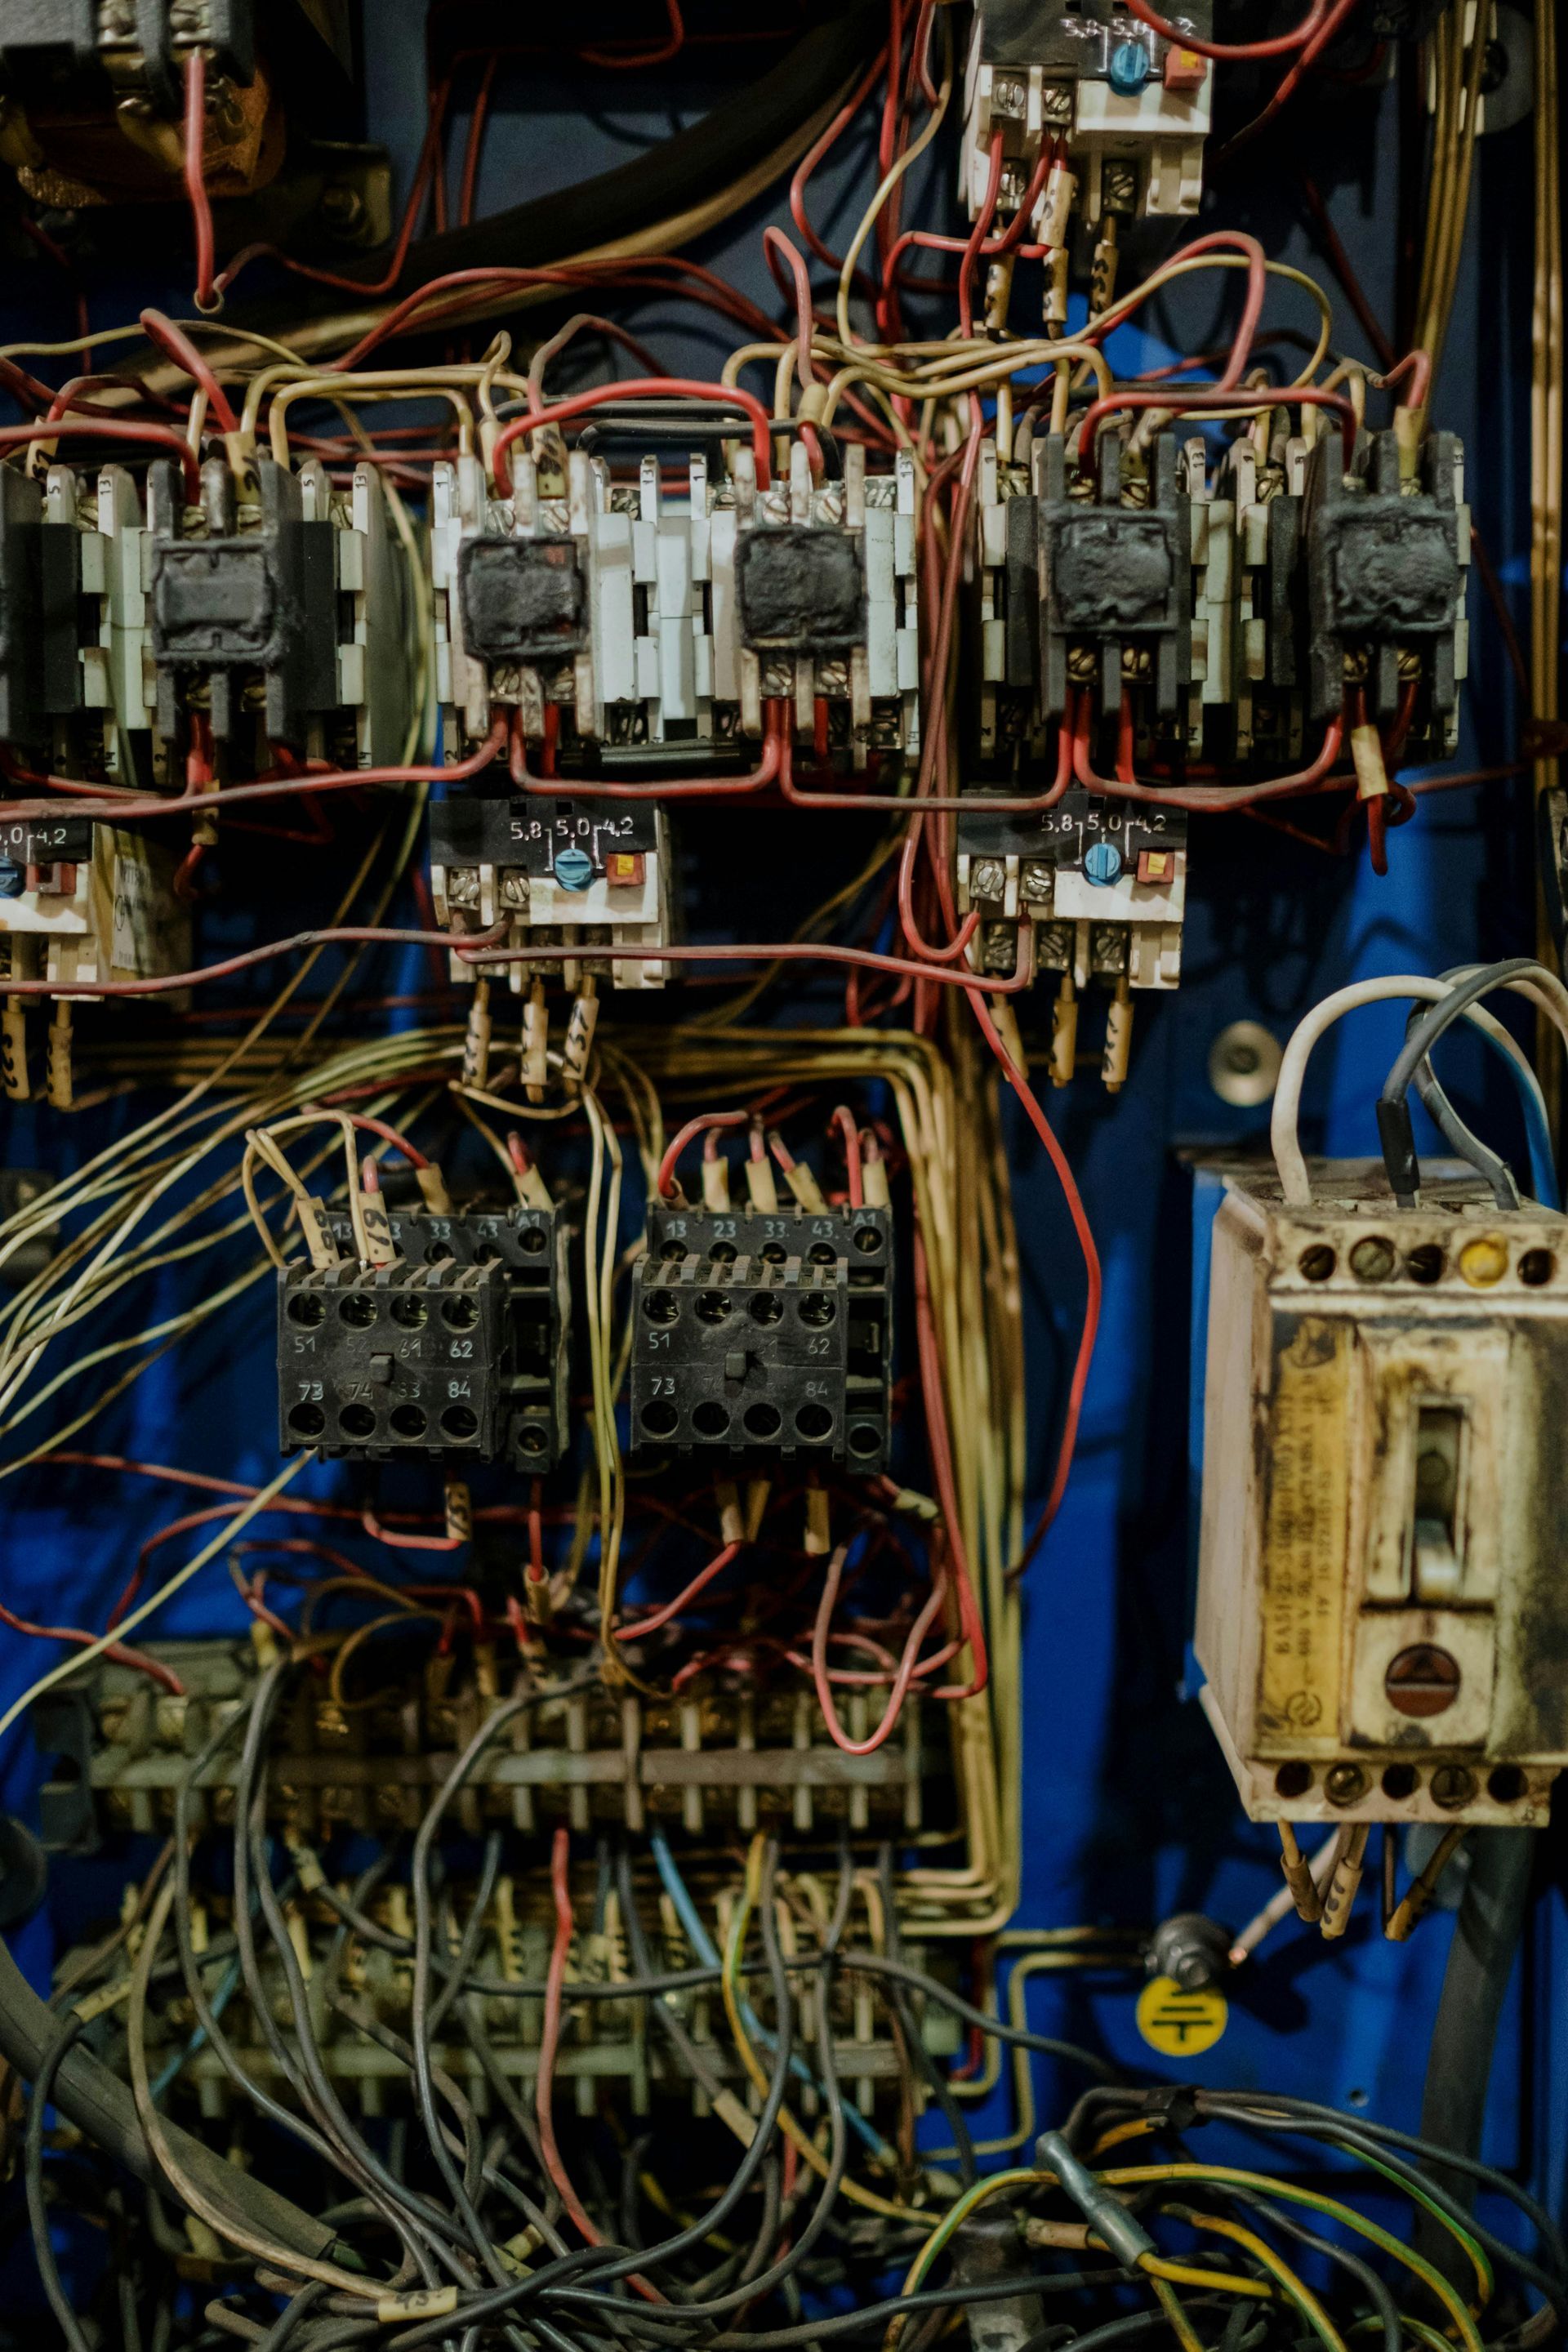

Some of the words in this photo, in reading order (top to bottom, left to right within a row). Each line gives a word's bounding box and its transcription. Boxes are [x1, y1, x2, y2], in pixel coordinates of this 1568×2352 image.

[1192, 452, 1205, 468] 13
[99, 479, 112, 495] 13
[354, 475, 368, 488] 13
[359, 751, 372, 765] 14
[445, 750, 458, 760] 2
[510, 821, 542, 840] 5,8
[556, 817, 590, 839] 5,0
[601, 817, 634, 837] 4,2
[1041, 814, 1073, 833] 5,8
[1087, 813, 1122, 833] 5,0
[1134, 815, 1167, 834] 4,2
[0, 826, 24, 846] ,0
[36, 827, 67, 847] 4,2
[517, 1214, 541, 1227] A1
[854, 1212, 876, 1226] A1
[332, 1221, 353, 1239] 13
[430, 1221, 451, 1239] 33
[476, 1222, 498, 1239] 43
[666, 1220, 687, 1238] 13
[713, 1221, 737, 1238] 23
[294, 1336, 316, 1353] 51
[399, 1338, 421, 1357] 61
[450, 1340, 474, 1358] 62
[648, 1332, 670, 1349] 51
[808, 1338, 831, 1355] 62
[298, 1381, 324, 1401] 73
[349, 1381, 373, 1401] 74
[448, 1380, 471, 1398] 84
[651, 1378, 675, 1396] 73
[804, 1381, 828, 1397] 84
